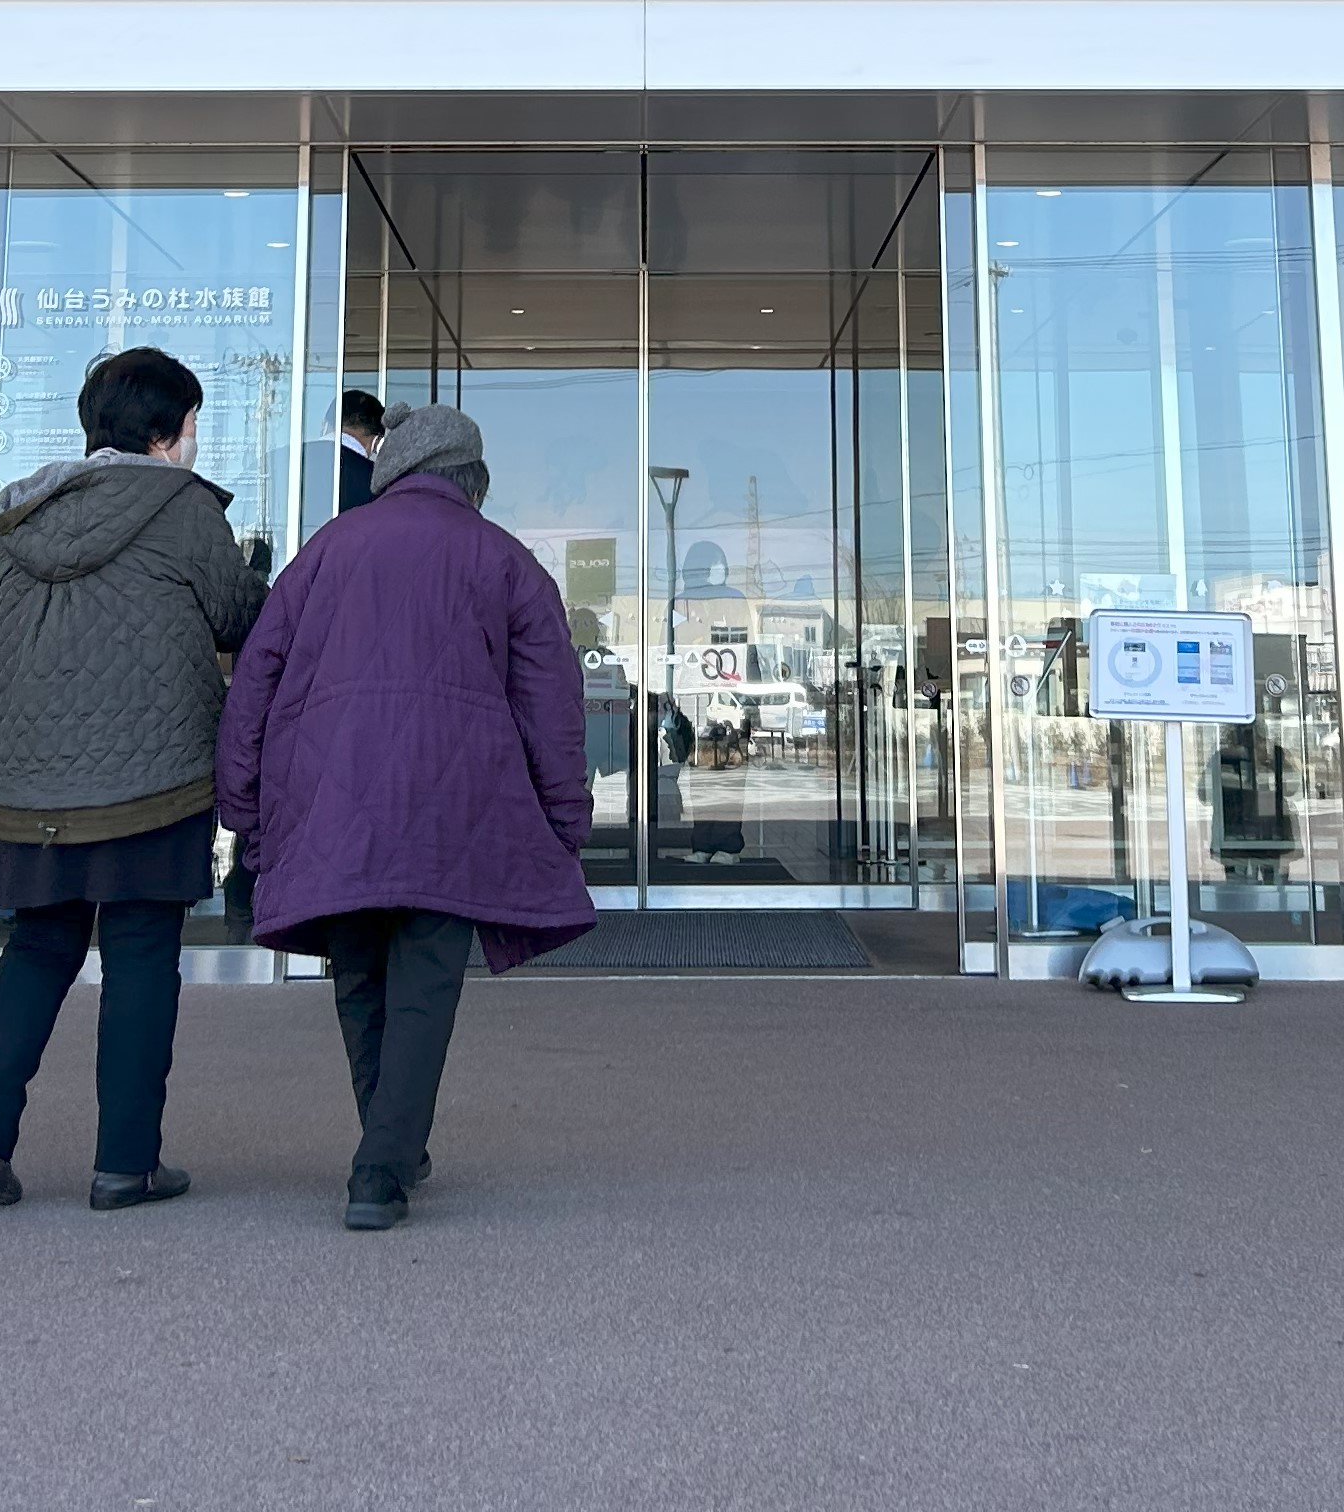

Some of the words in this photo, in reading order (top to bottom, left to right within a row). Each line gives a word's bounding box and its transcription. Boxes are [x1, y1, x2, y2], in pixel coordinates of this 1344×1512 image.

[37, 286, 271, 310] 仙台うみの杜水族館
[36, 315, 89, 325] SENDAI
[96, 315, 188, 325] UMINO-MORI
[195, 314, 272, 325] AQUARIUM
